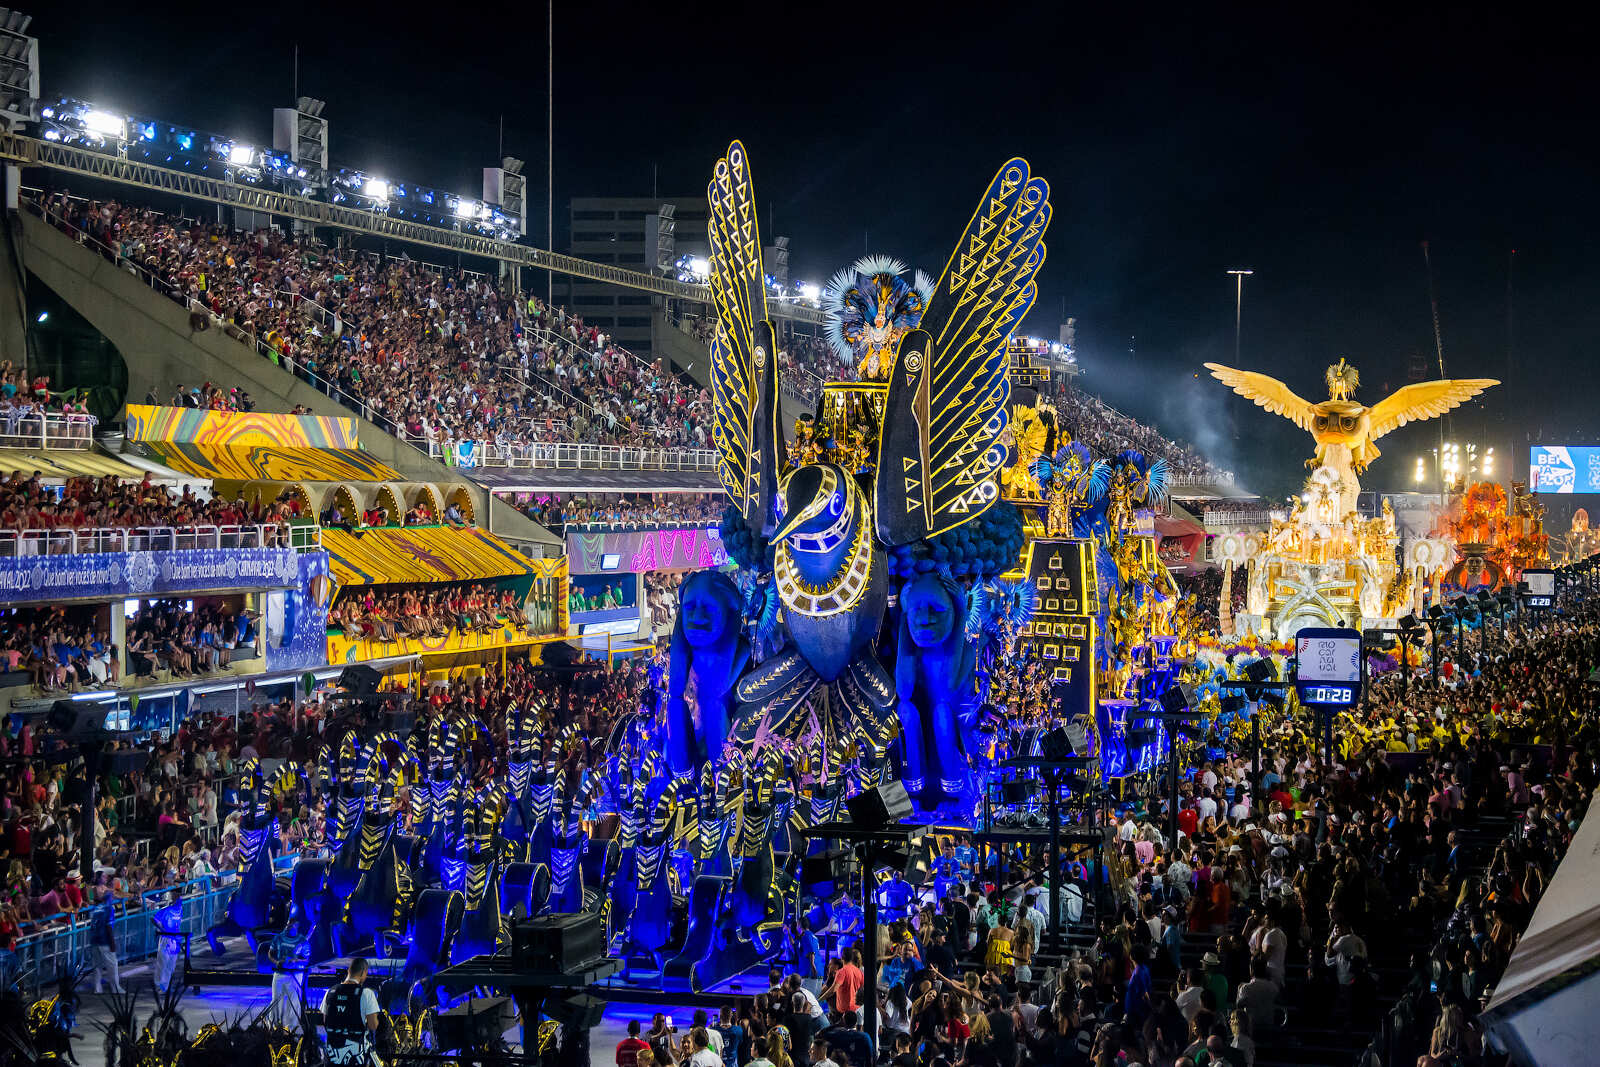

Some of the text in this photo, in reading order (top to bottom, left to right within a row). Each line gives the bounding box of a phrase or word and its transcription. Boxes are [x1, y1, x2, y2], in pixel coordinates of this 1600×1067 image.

[1537, 454, 1560, 465] BEI
[1539, 474, 1574, 486] FLOR
[238, 560, 274, 578] CARNAVAL 2022
[15, 570, 31, 591] 2022
[1531, 598, 1550, 606] 028
[1316, 688, 1351, 702] 0:28
[336, 1005, 346, 1013] TV
